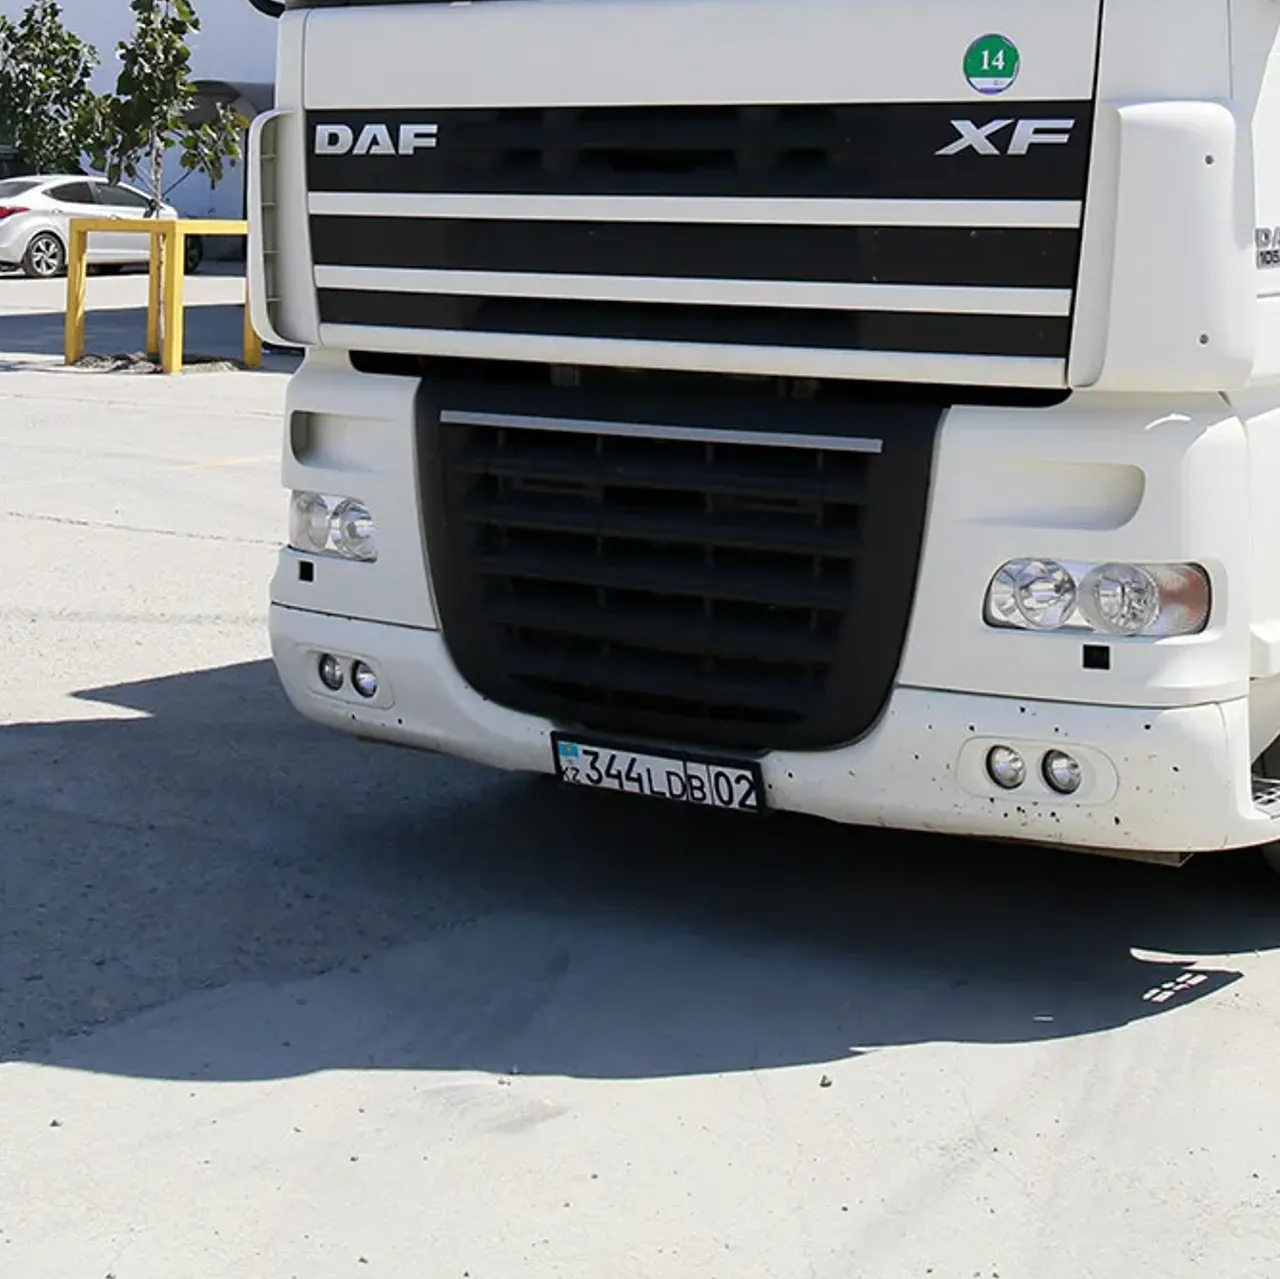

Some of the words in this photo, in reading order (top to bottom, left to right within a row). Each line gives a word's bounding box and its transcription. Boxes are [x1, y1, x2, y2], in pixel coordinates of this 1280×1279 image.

[980, 48, 1006, 71] 14
[314, 123, 439, 157] DAF
[934, 117, 1076, 157] XF
